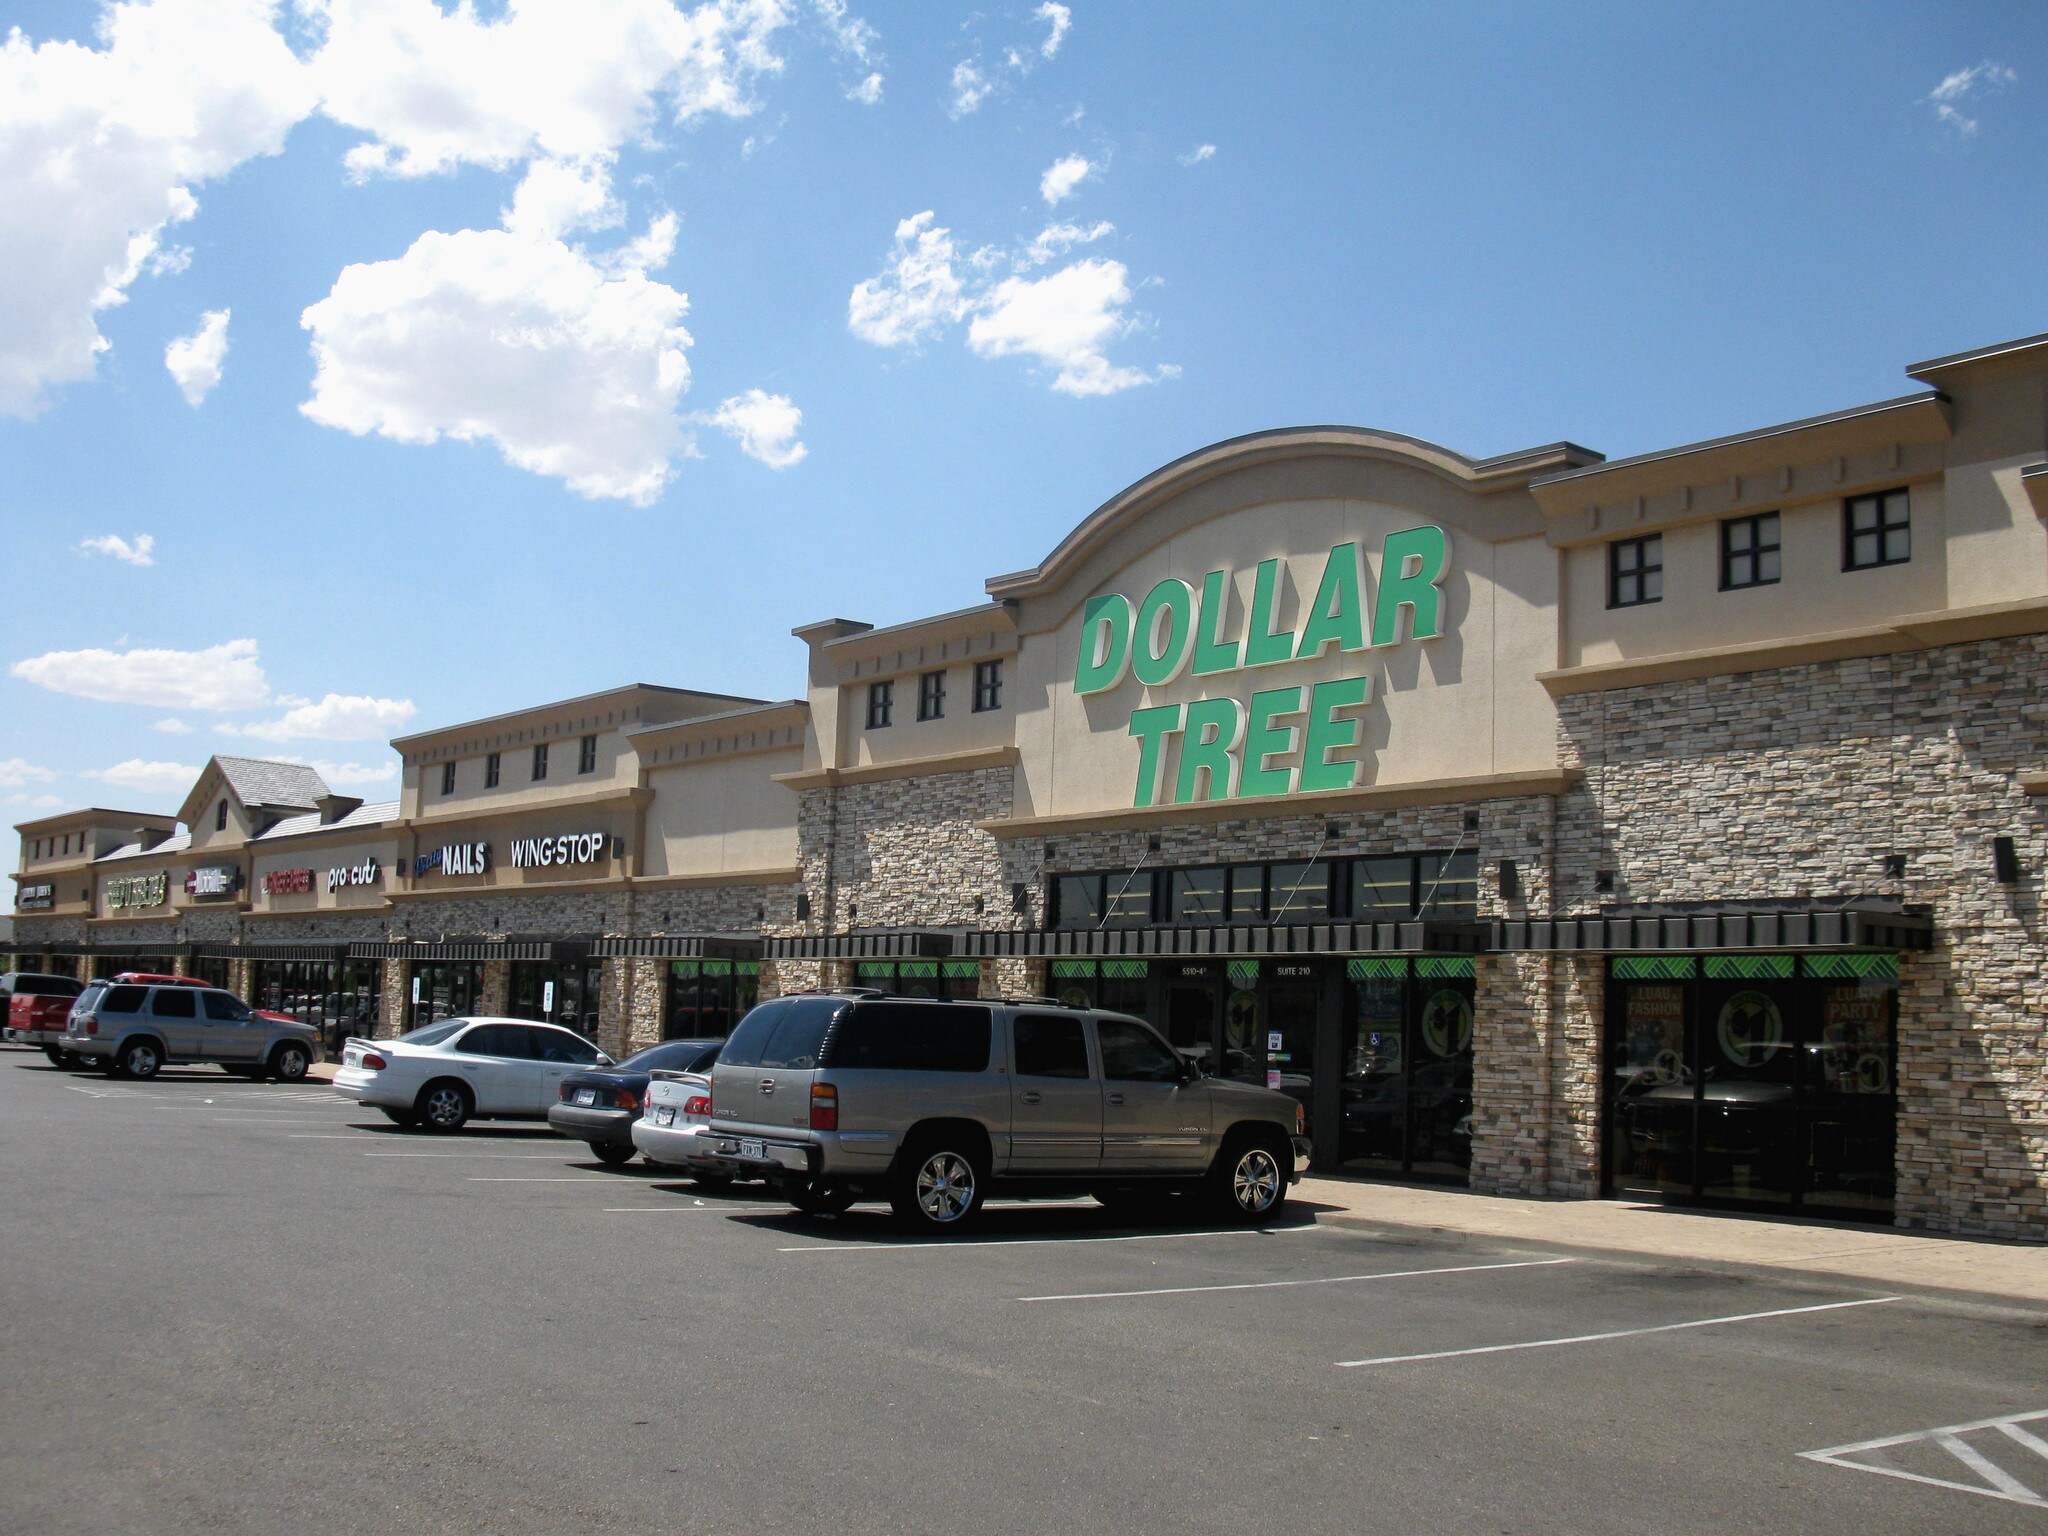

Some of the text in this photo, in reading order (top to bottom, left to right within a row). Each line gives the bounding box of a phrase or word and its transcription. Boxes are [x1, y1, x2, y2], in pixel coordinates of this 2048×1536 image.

[1073, 524, 1453, 695] DOLLAR
[1128, 675, 1375, 808] TREE
[442, 842, 485, 876] NAILS
[328, 866, 347, 894] pro
[351, 857, 377, 885] cuts
[1277, 967, 1311, 976] SUITE 210
[1639, 986, 1670, 1001] LUAU
[1628, 1002, 1681, 1017] FASHION
[1830, 1002, 1881, 1019] PARTY
